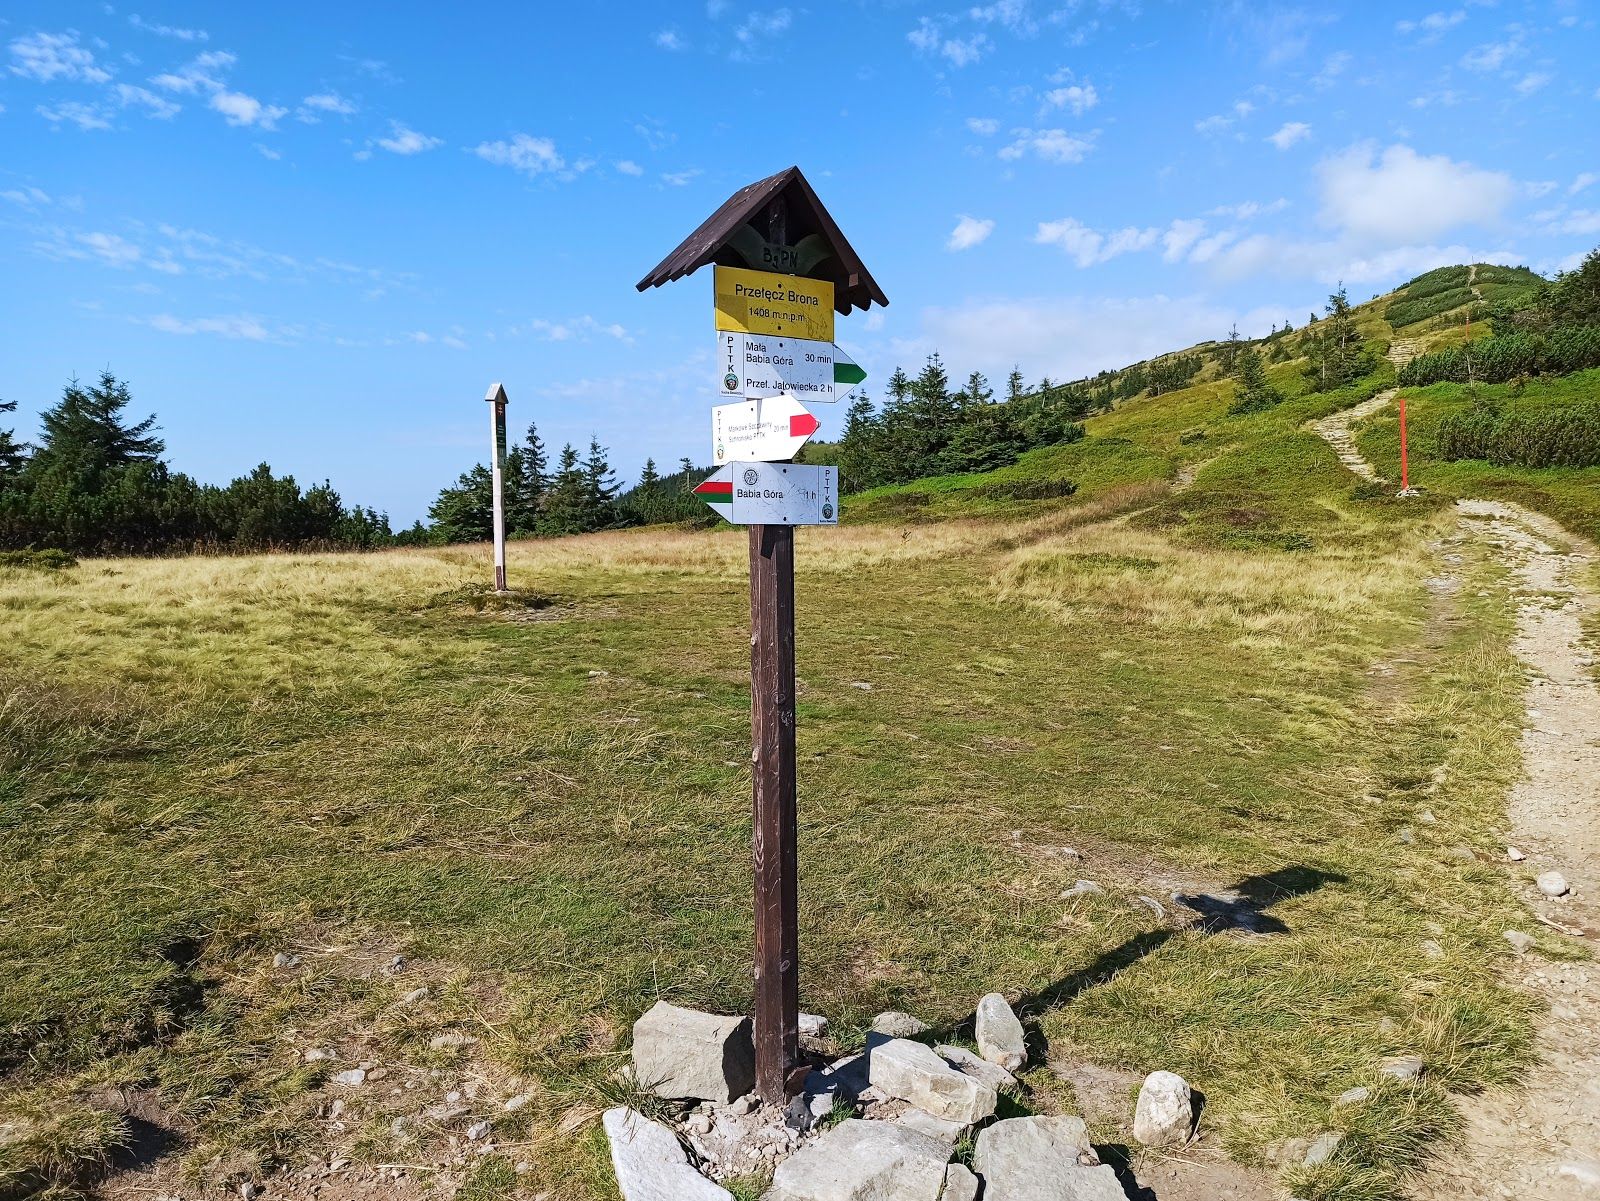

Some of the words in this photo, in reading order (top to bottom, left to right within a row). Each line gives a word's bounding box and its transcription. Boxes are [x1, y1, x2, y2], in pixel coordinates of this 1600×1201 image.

[735, 284, 785, 302] Przełęcz
[787, 291, 819, 306] Brona
[748, 307, 771, 319] 1408
[745, 342, 767, 352] Mała
[727, 336, 735, 374] PTTK
[746, 353, 771, 364] Babia
[773, 354, 794, 366] Góra
[805, 353, 815, 363] 30
[817, 354, 832, 364] min
[772, 379, 818, 392] Jałowiecka
[820, 383, 826, 392] 2
[827, 384, 833, 393] h
[737, 488, 762, 498] Babia
[763, 489, 784, 499] Góra
[811, 490, 817, 500] h
